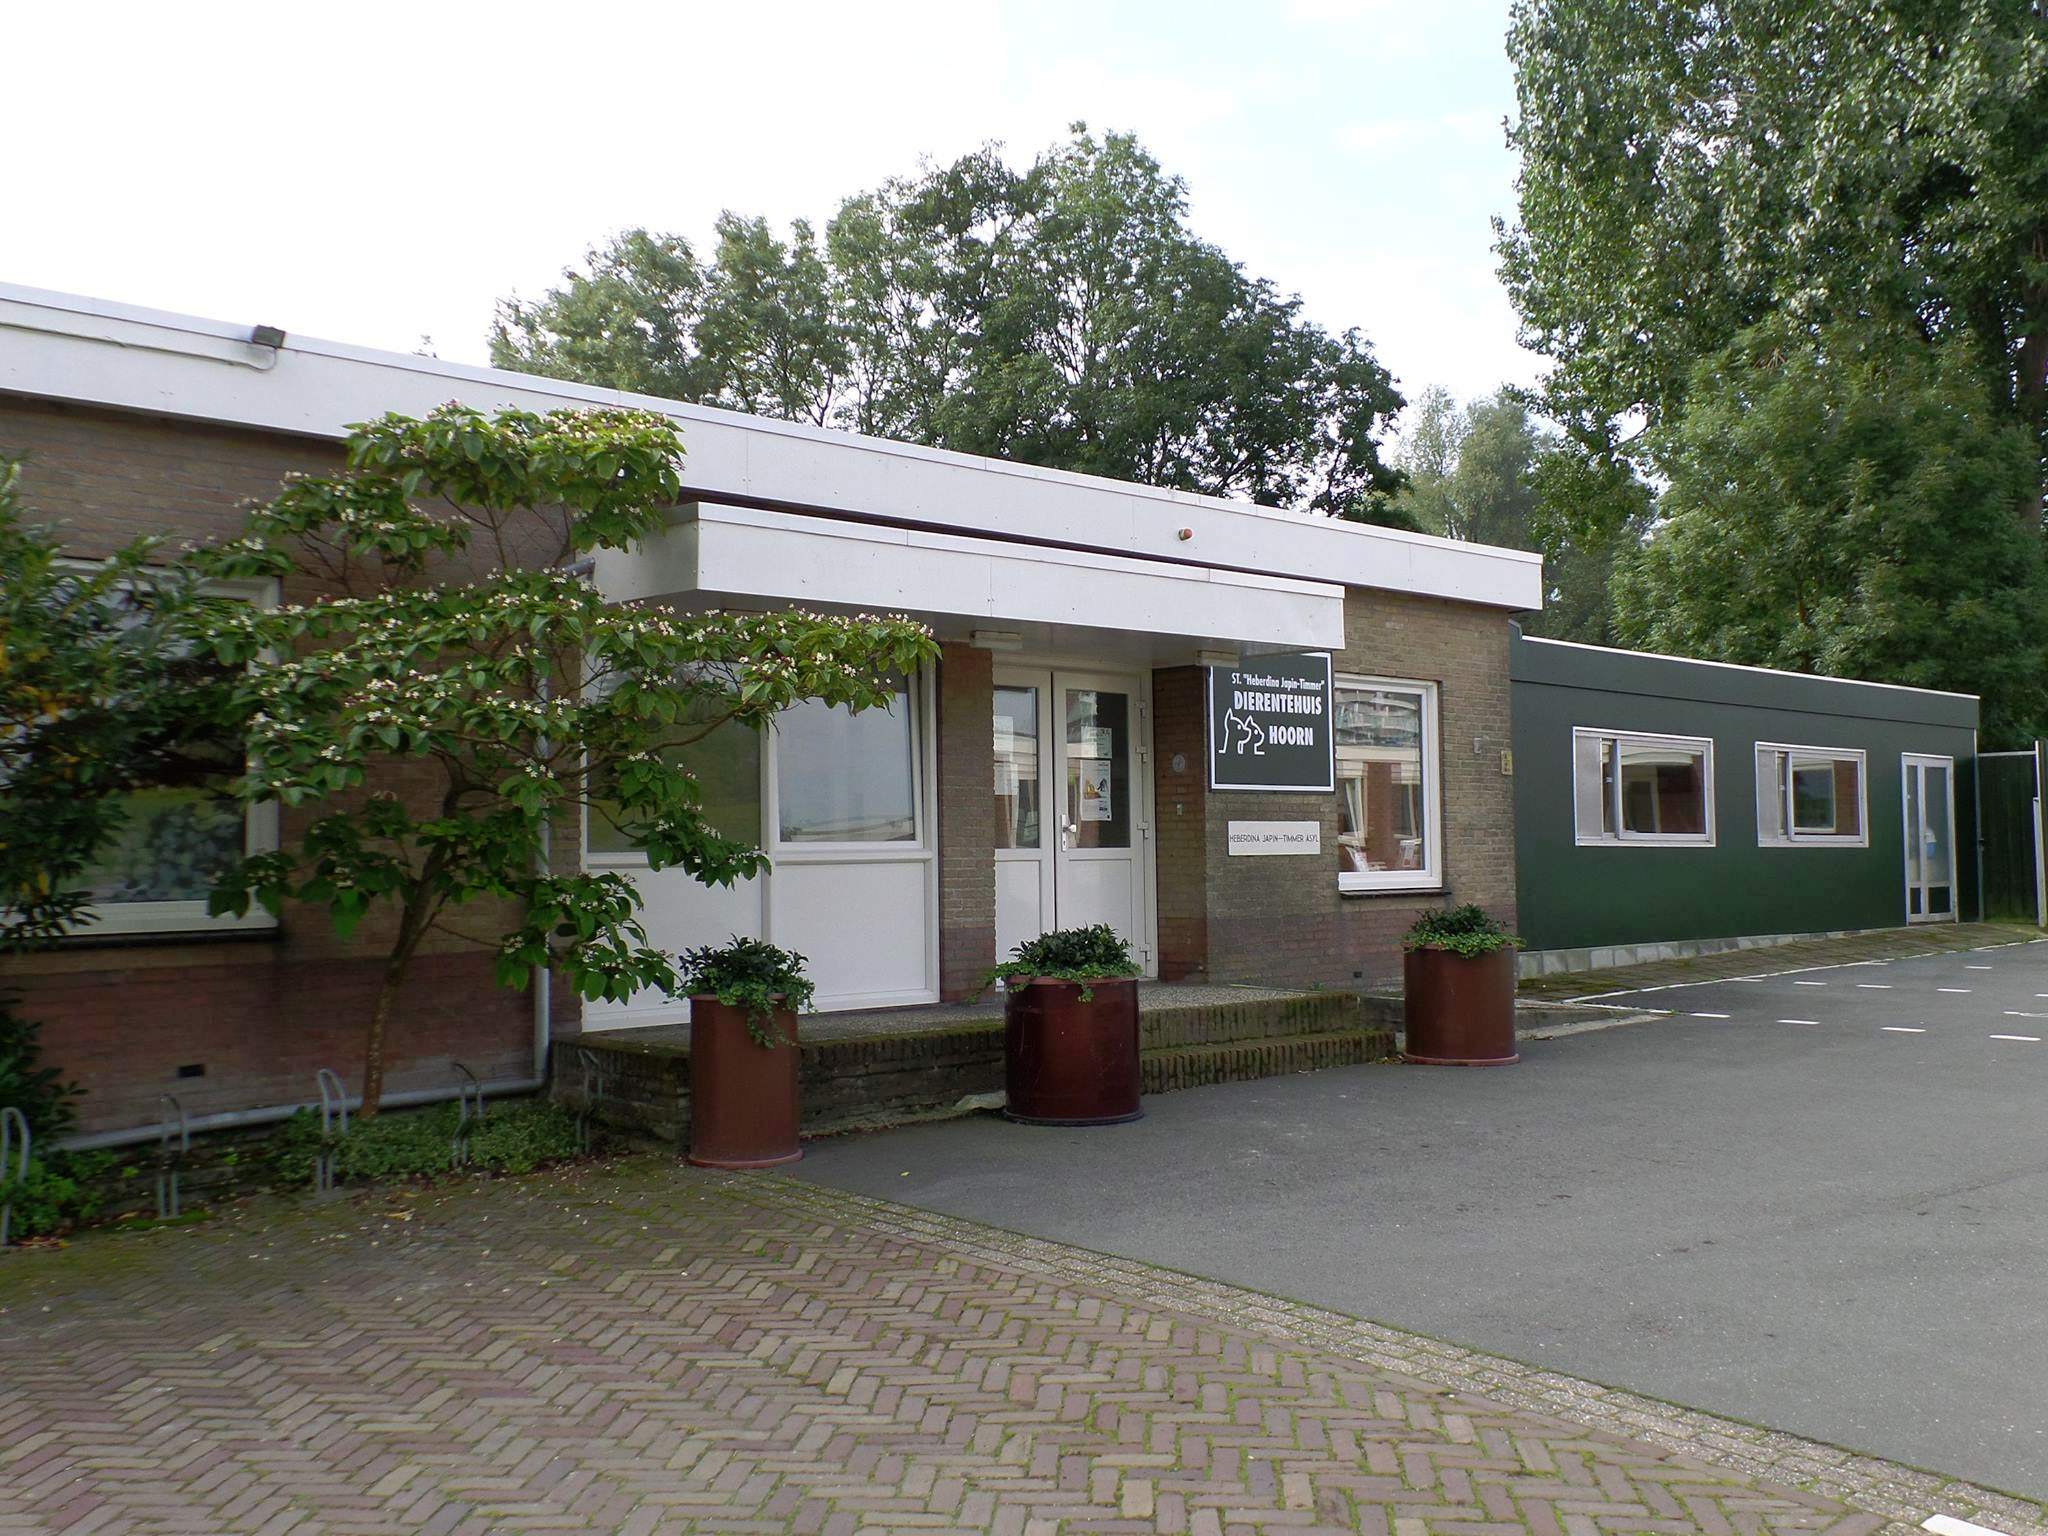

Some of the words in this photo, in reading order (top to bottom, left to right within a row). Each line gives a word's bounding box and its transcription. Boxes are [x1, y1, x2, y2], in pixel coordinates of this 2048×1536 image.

[1233, 690, 1322, 715] DIERENTEHUIS
[1269, 725, 1314, 746] HOORN
[1230, 834, 1260, 843] HEBERDINA
